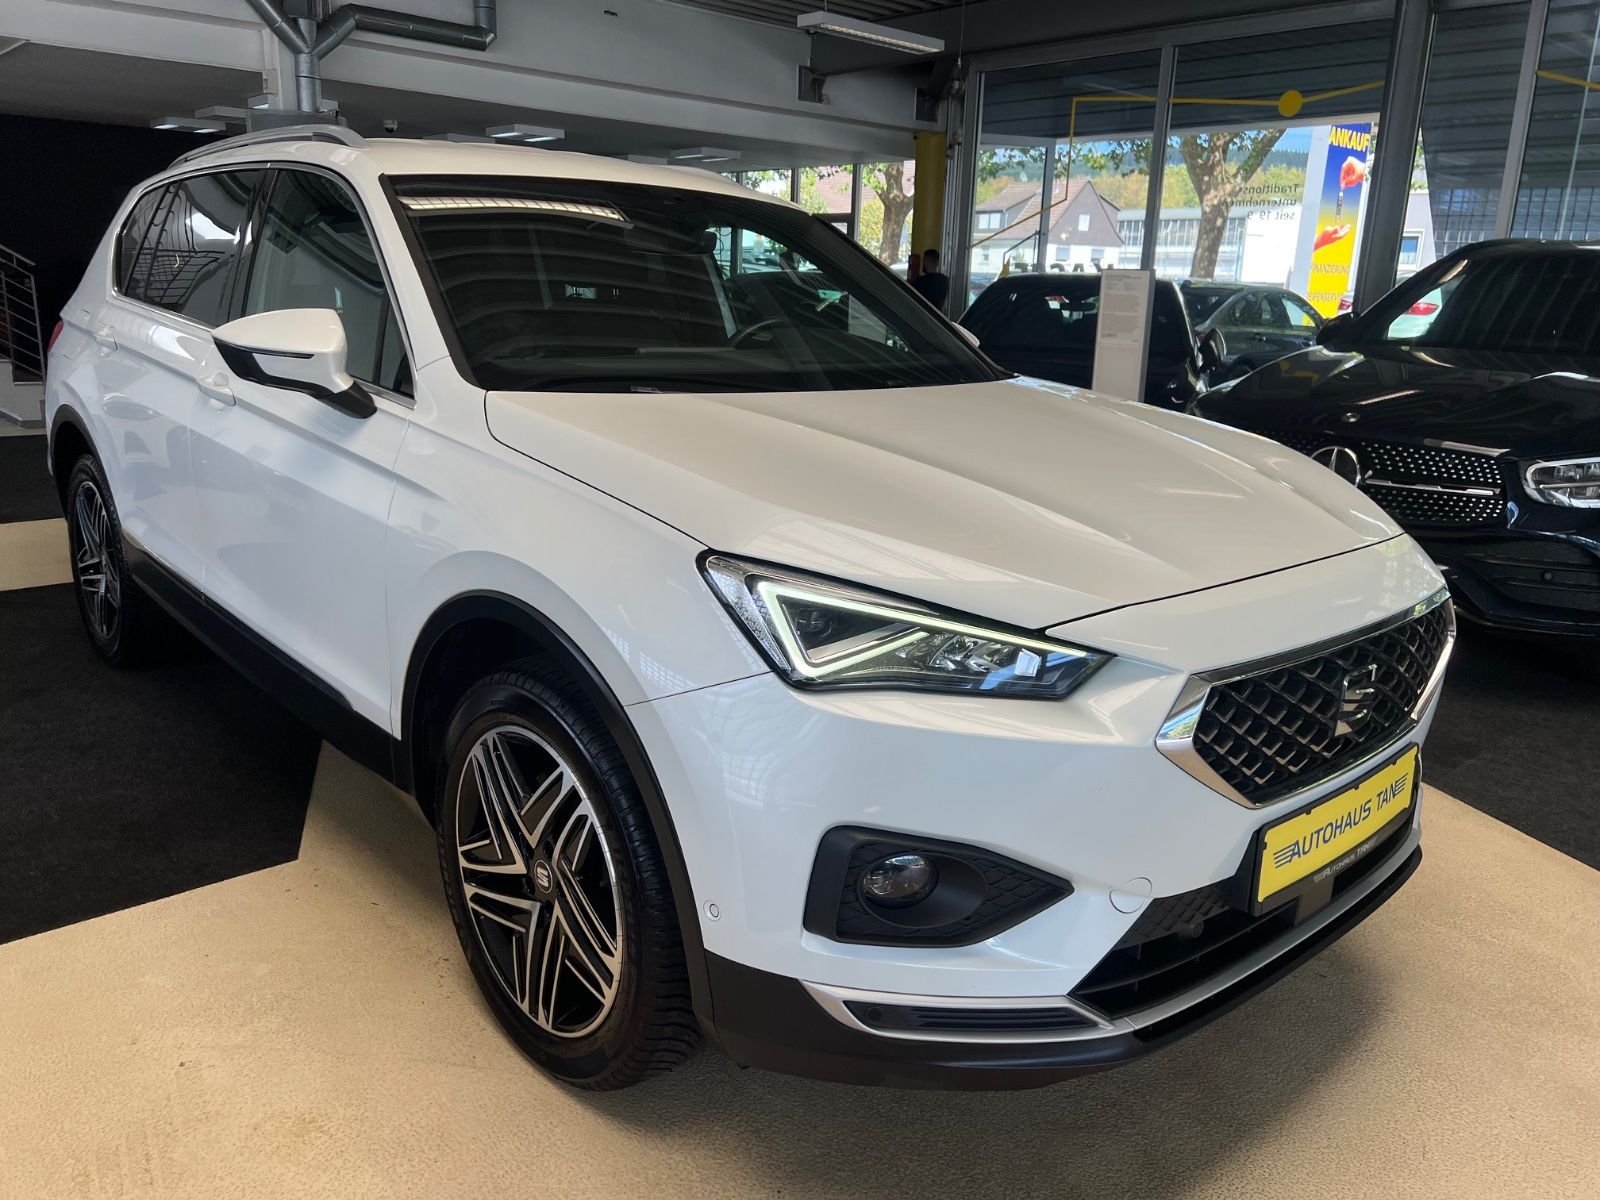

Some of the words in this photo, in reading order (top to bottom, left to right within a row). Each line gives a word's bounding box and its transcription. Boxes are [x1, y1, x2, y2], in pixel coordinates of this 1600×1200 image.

[1328, 126, 1371, 152] ANKAUF
[1288, 798, 1372, 863] AUTOHAUS
[1376, 781, 1400, 811] TAN
